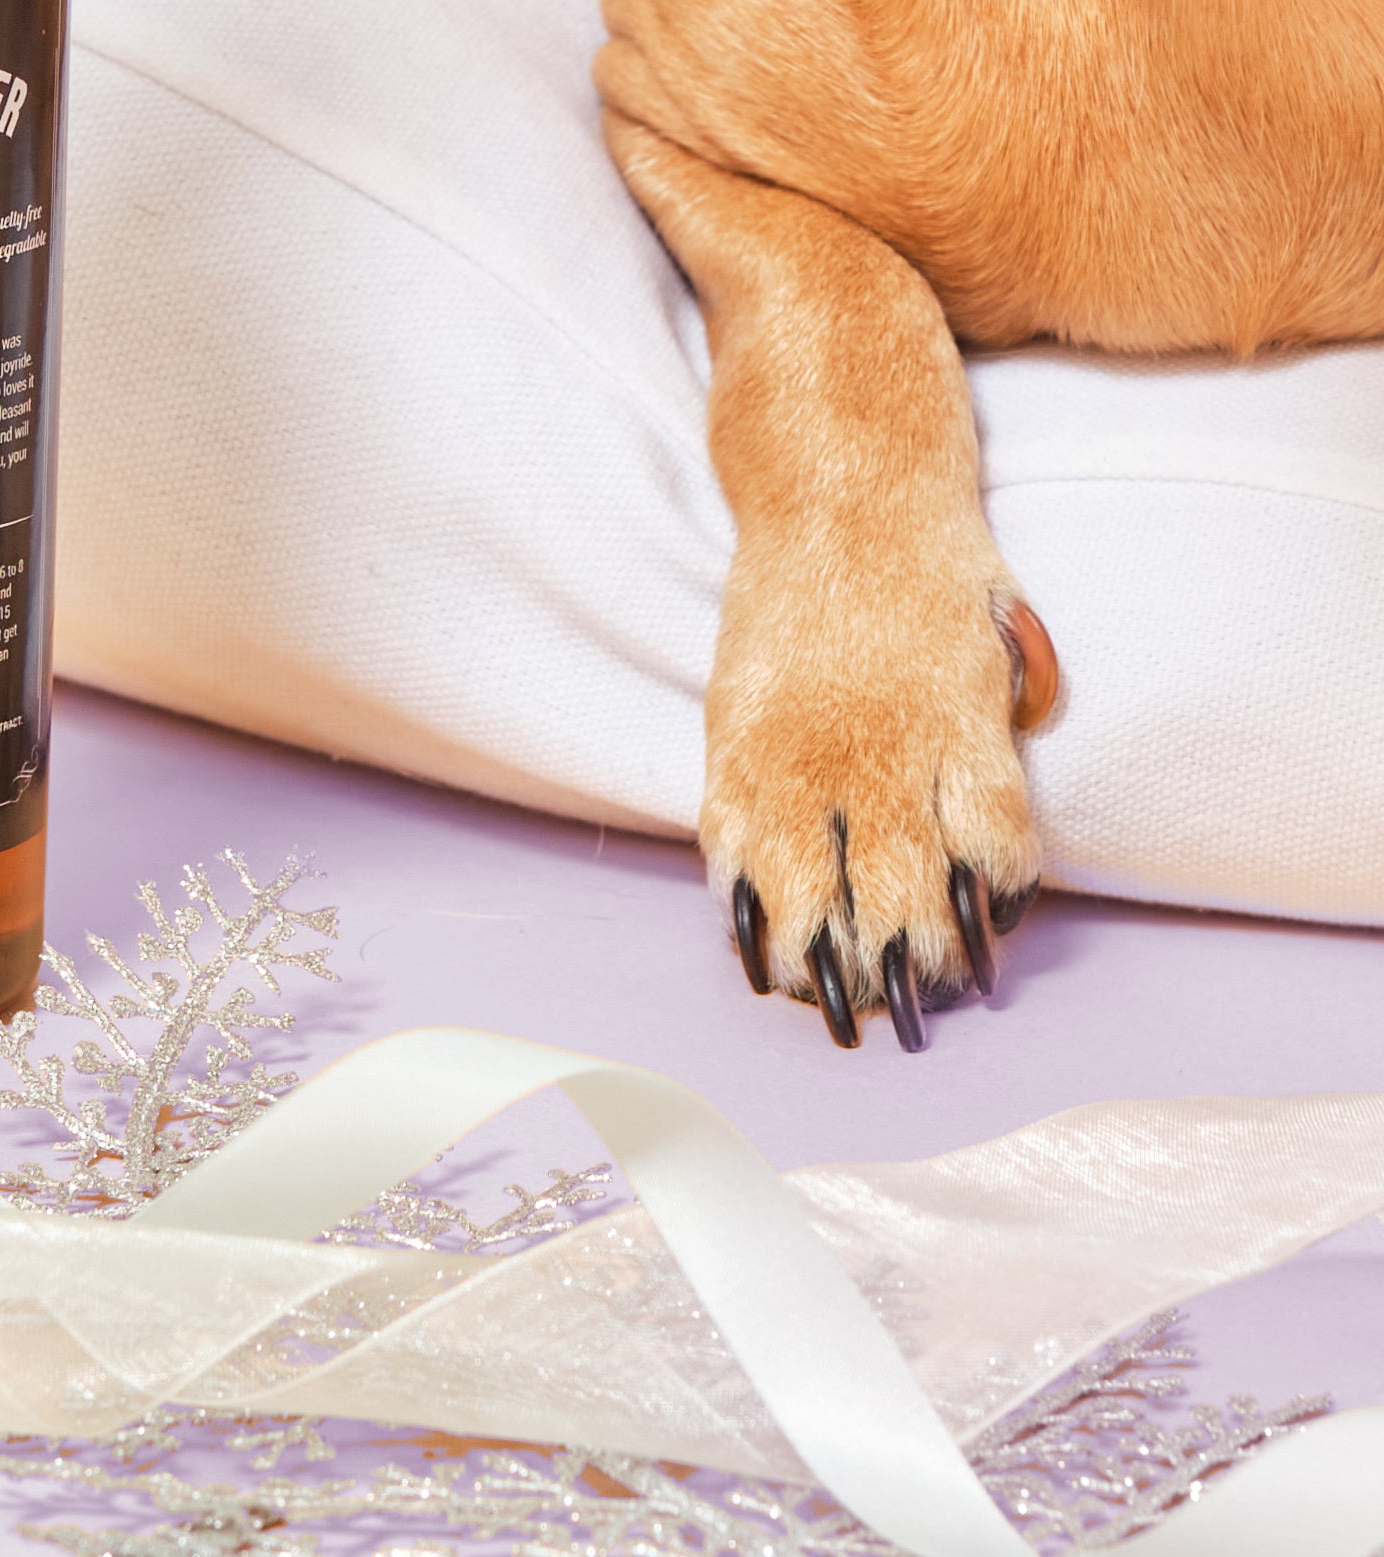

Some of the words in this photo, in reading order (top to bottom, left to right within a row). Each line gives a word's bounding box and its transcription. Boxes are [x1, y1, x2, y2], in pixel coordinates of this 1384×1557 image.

[2, 334, 21, 350] was
[3, 380, 27, 397] loves
[14, 420, 29, 439] will
[8, 447, 27, 469] your
[0, 605, 10, 620] 15
[4, 624, 17, 643] get
